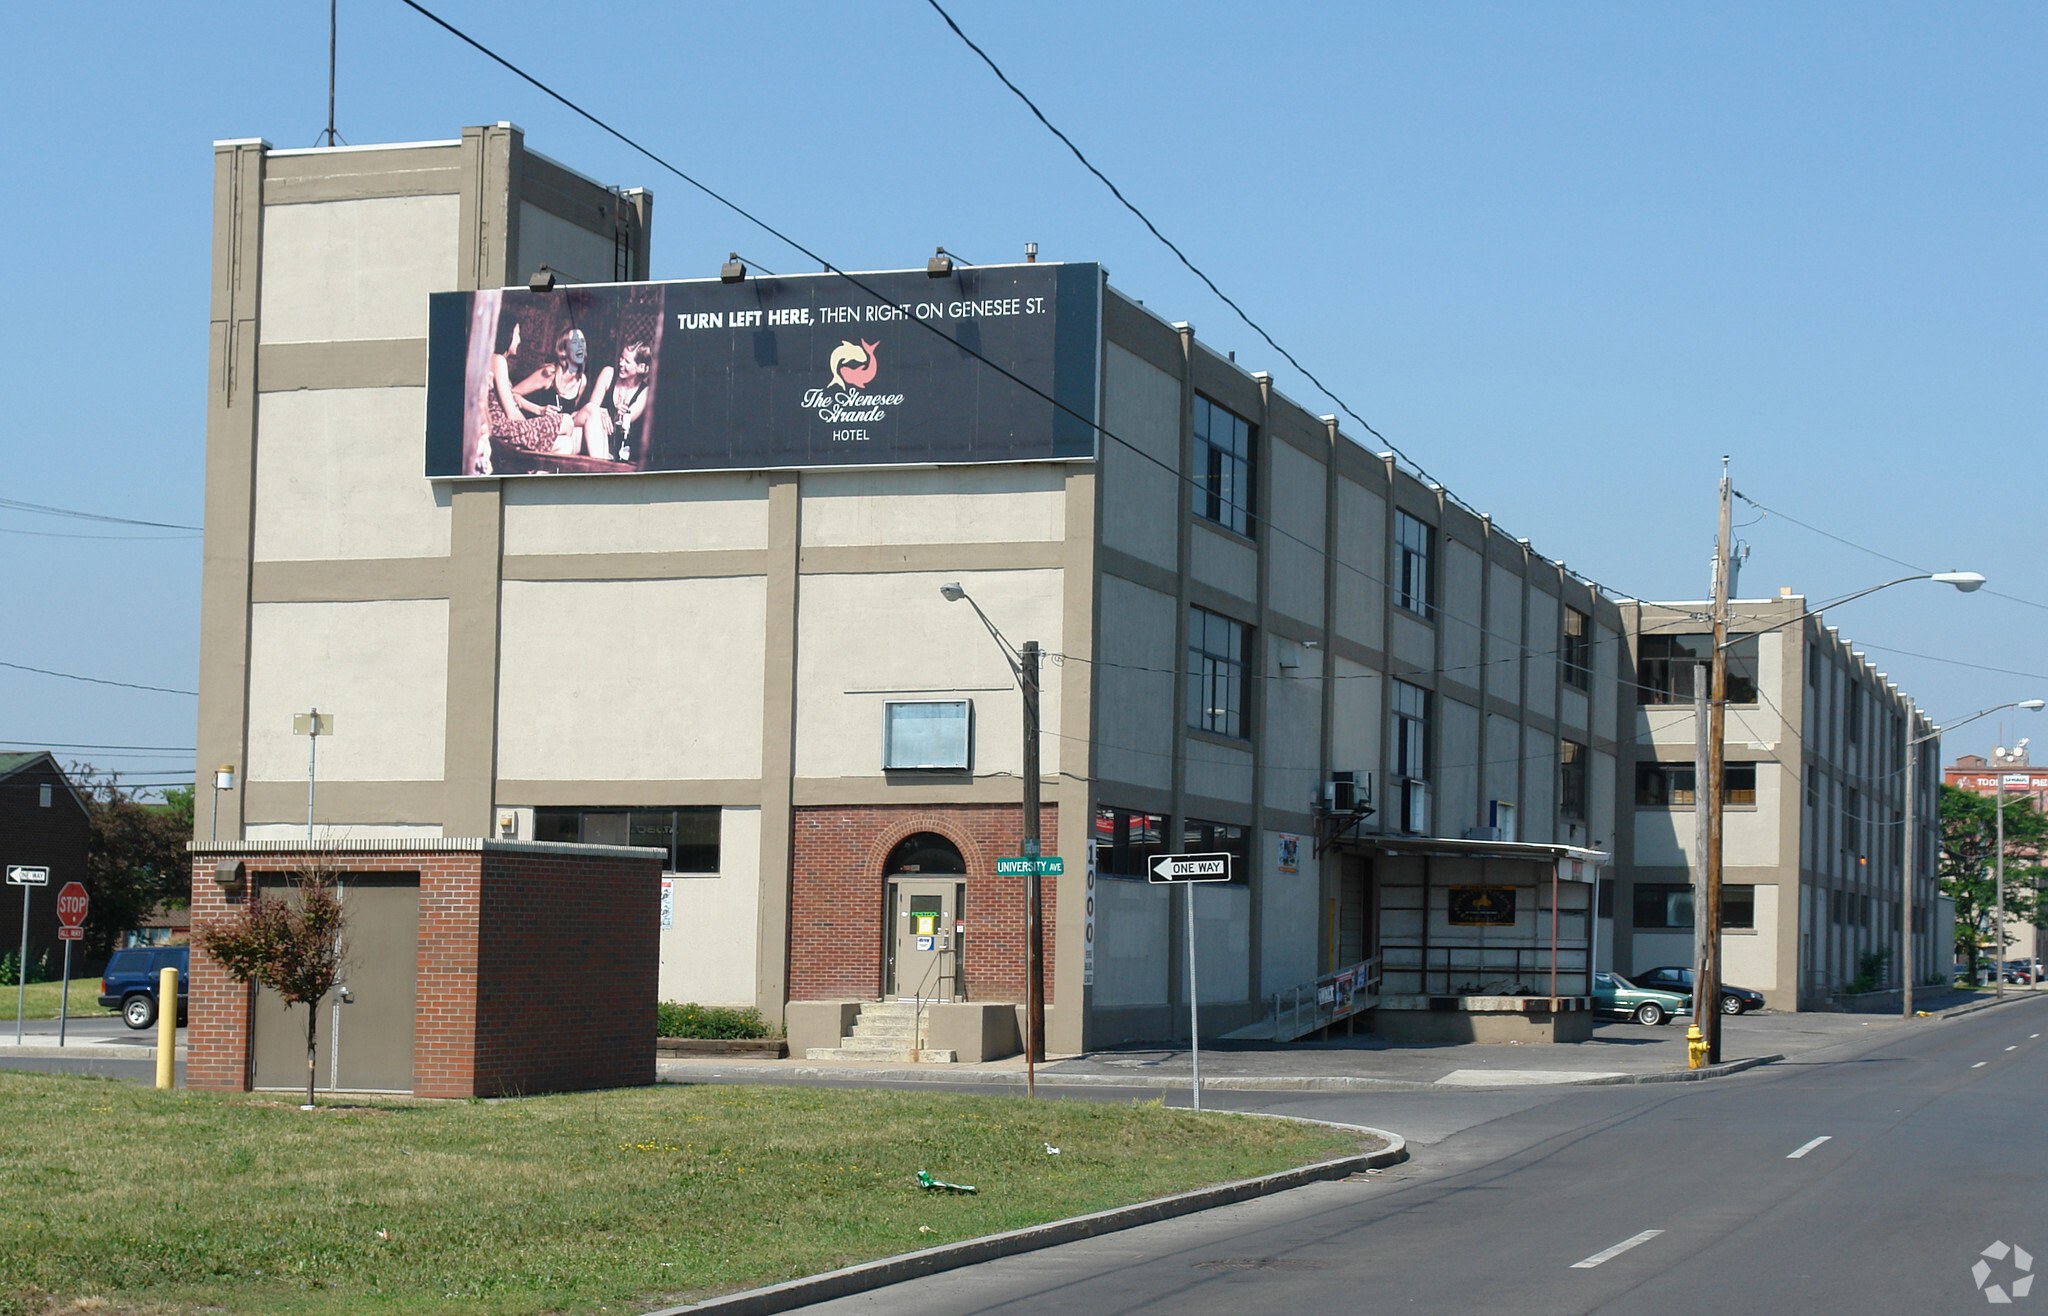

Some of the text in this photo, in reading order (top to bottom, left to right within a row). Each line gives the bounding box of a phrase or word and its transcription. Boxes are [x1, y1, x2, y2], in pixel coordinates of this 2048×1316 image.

[677, 297, 1046, 330] TURN LEFT HERE, THEN RIGHT ON GENESEE ST.
[801, 387, 905, 408] The Genesee
[818, 403, 886, 423] Grande
[832, 429, 870, 441] HOTEL
[997, 861, 1062, 873] UNIVERSITY AVE
[1172, 862, 1221, 874] ONE WAY
[1086, 844, 1094, 944] 1000
[59, 896, 86, 913] STOP
